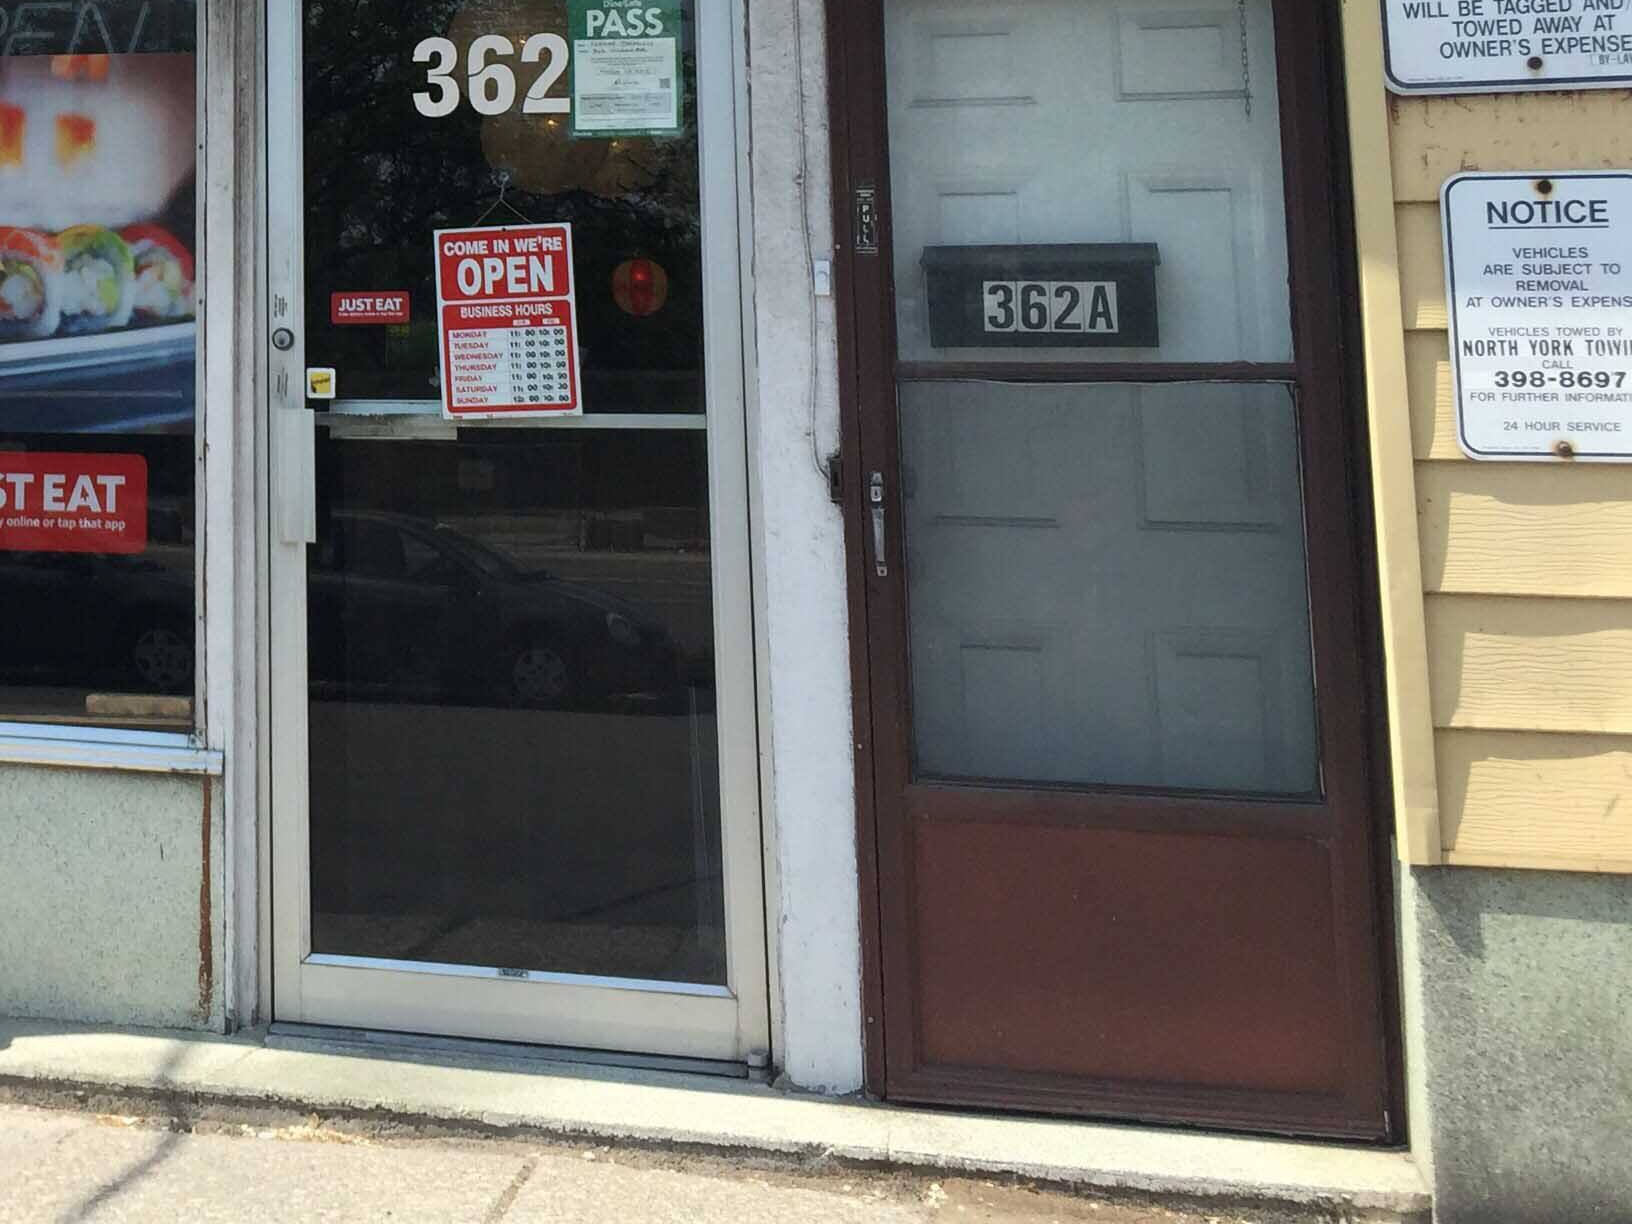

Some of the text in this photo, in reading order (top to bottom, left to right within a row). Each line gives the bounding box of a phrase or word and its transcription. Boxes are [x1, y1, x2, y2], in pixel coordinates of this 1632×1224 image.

[1403, 1, 1448, 19] WILL
[1459, 0, 1483, 17] BE
[586, 7, 664, 37] PASS
[1452, 14, 1616, 38] TOWED AWAY AT
[1440, 34, 1632, 60] OWNER'S EXPENSE
[412, 33, 571, 117] 362
[1487, 200, 1609, 224] NOTICE
[443, 236, 563, 256] COME IN WE'RE
[1512, 247, 1588, 259] VEHICLES
[457, 254, 555, 296] OPEN
[1483, 263, 1621, 276] ARE SUBJECT TO
[1516, 280, 1589, 292] REMOVAL
[338, 298, 403, 311] JUST EAT
[460, 303, 552, 318] BUSINESS HOURS
[988, 284, 1114, 330] 362A
[1466, 296, 1483, 308] AT
[1491, 296, 1563, 308] OWNER'S
[1488, 327, 1623, 337] VEHICLES TOWED BY
[1463, 339, 1518, 357] NORTH
[1529, 339, 1574, 356] YORK
[1542, 360, 1573, 369] CALL
[1495, 371, 1627, 388] 398-8697
[1470, 392, 1495, 402] FOR
[1502, 392, 1559, 402] FURTHER
[1504, 421, 1621, 432] 24 HOUR SERVICE
[43, 473, 126, 513] EAT
[6, 514, 40, 527] online
[43, 517, 56, 527] or
[58, 516, 76, 530] tap
[79, 516, 102, 529] that
[105, 519, 126, 531] app
